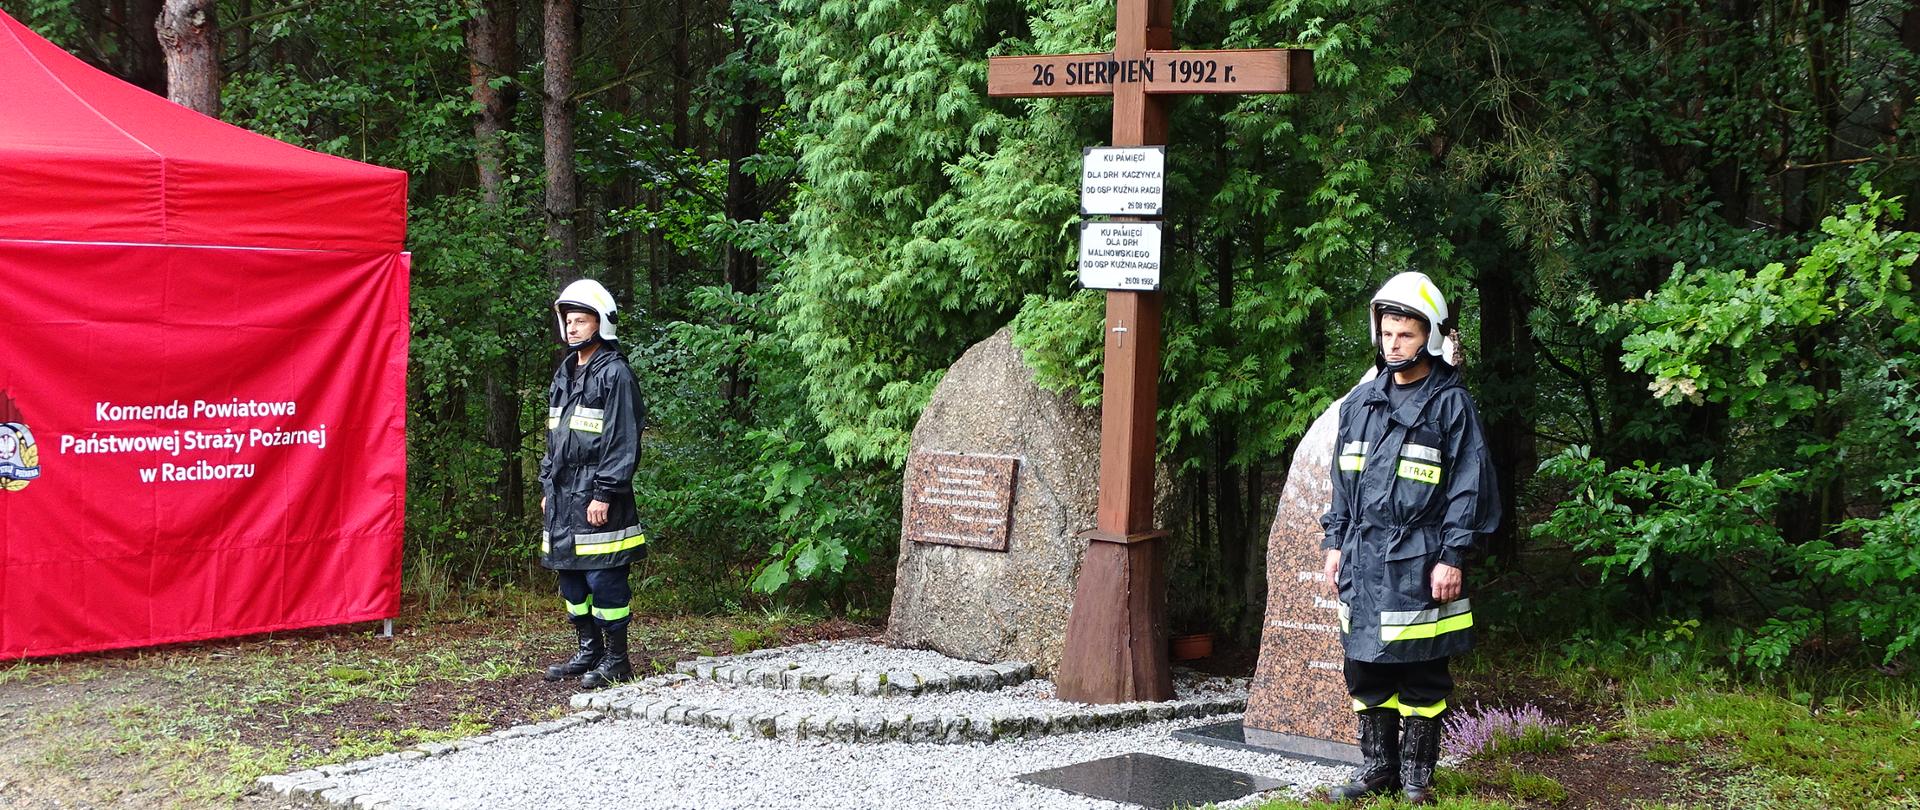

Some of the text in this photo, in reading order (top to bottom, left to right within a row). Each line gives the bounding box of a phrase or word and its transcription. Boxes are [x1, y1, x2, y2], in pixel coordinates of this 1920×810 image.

[1032, 57, 1237, 86] 26 SIERPIEŃ 1992 r.
[1103, 153, 1114, 162] KU
[1087, 171, 1102, 179] DLA
[1103, 171, 1119, 179] DRH
[1086, 186, 1096, 194] OD
[1097, 186, 1112, 194] OSP
[1100, 229, 1112, 237] KU
[1105, 238, 1139, 246] DLA DRH
[1087, 248, 1150, 259] MALINOWSKIEGO
[1083, 260, 1094, 268] OD
[1094, 260, 1109, 269] OSP
[95, 397, 297, 422] Komenda Powiatowa
[60, 424, 327, 457] Państwowej Straży Pożarnej
[139, 460, 256, 483] w Raciborzu
